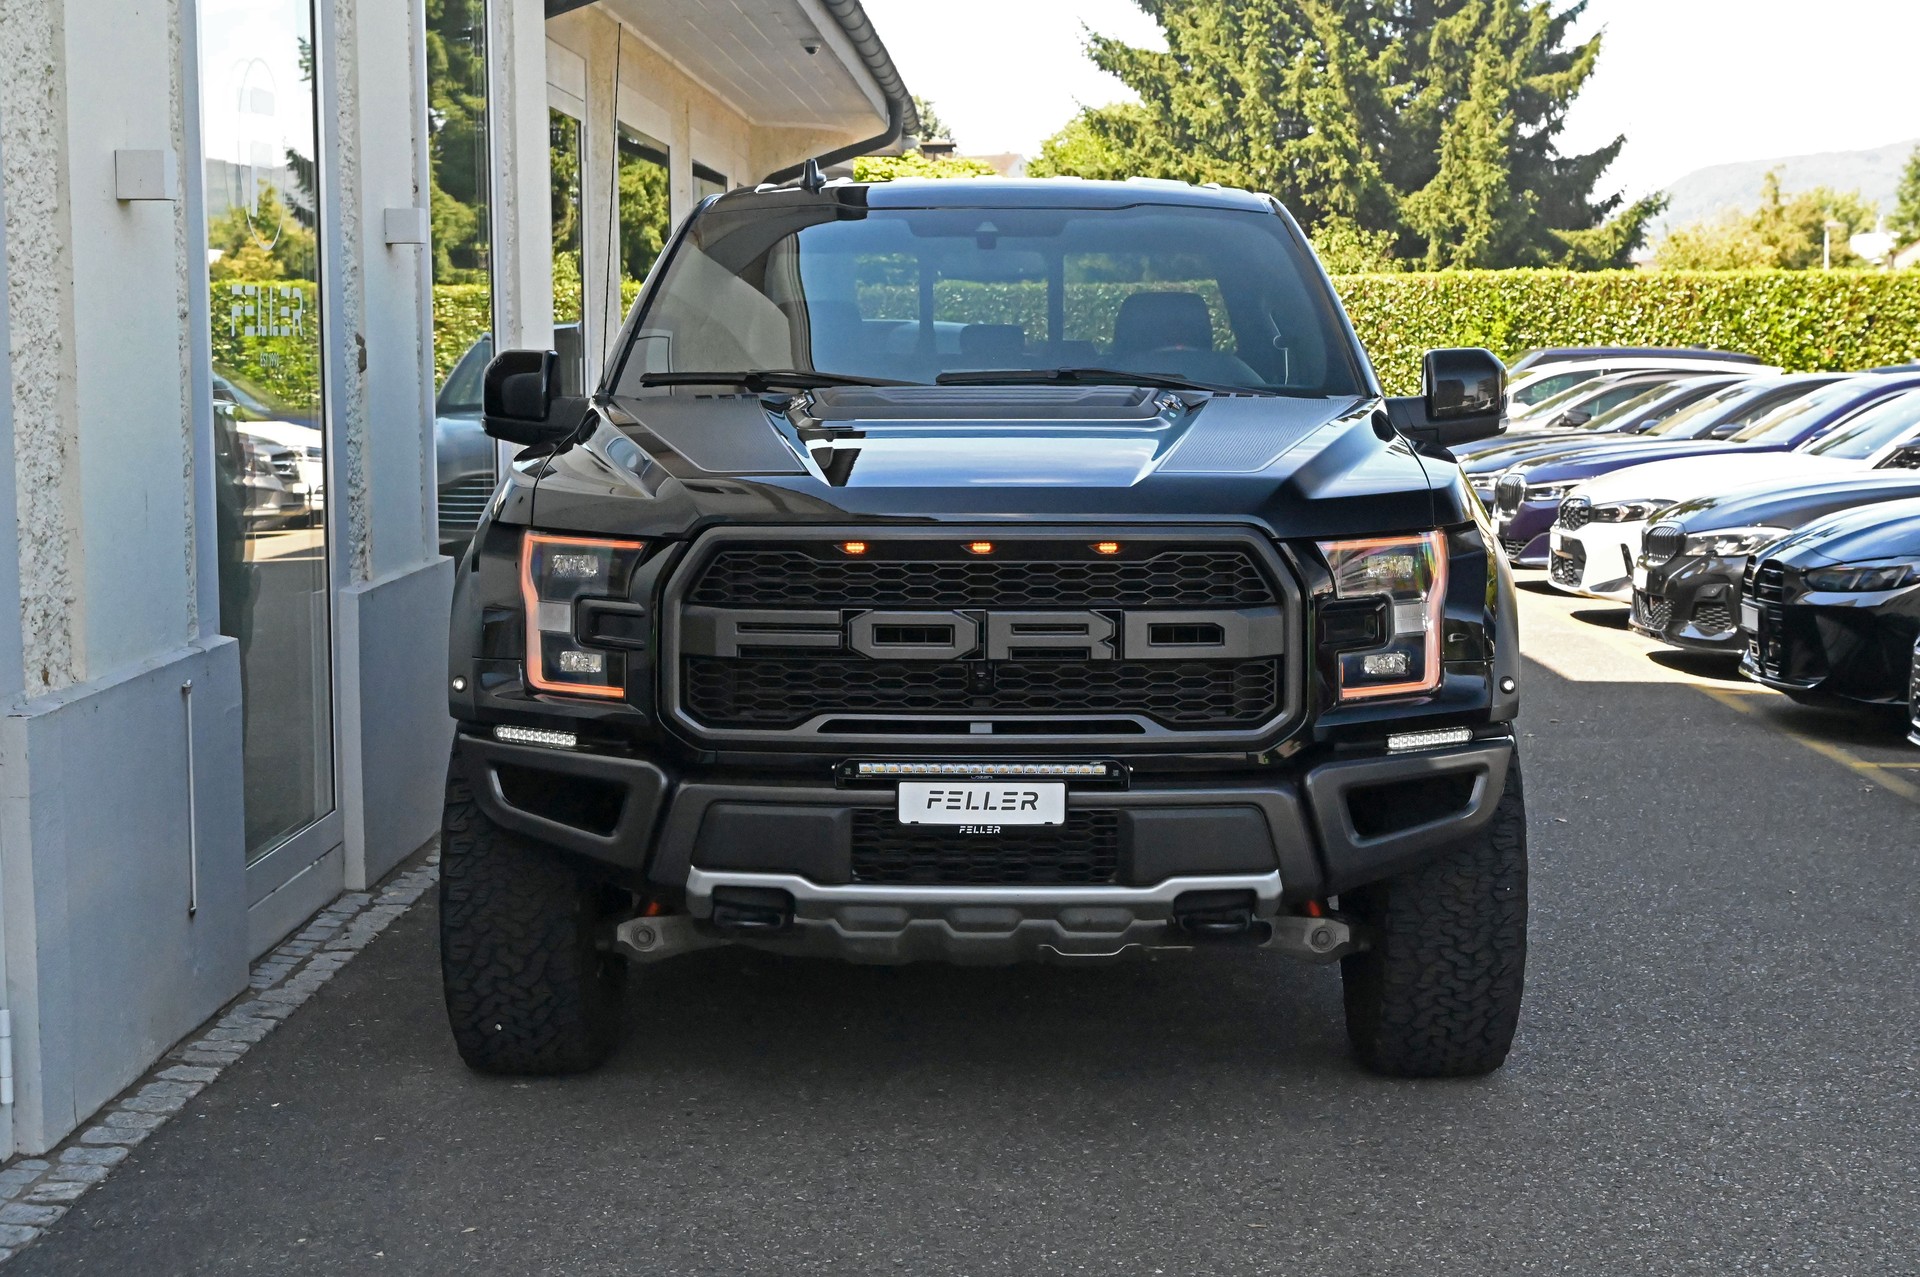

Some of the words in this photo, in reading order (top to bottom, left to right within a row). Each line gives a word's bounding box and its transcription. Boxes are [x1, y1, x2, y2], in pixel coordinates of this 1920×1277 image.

[231, 284, 304, 337] FELLER
[716, 608, 1250, 660] FORD
[926, 790, 1039, 811] FELLER
[958, 825, 1001, 834] FELLER
